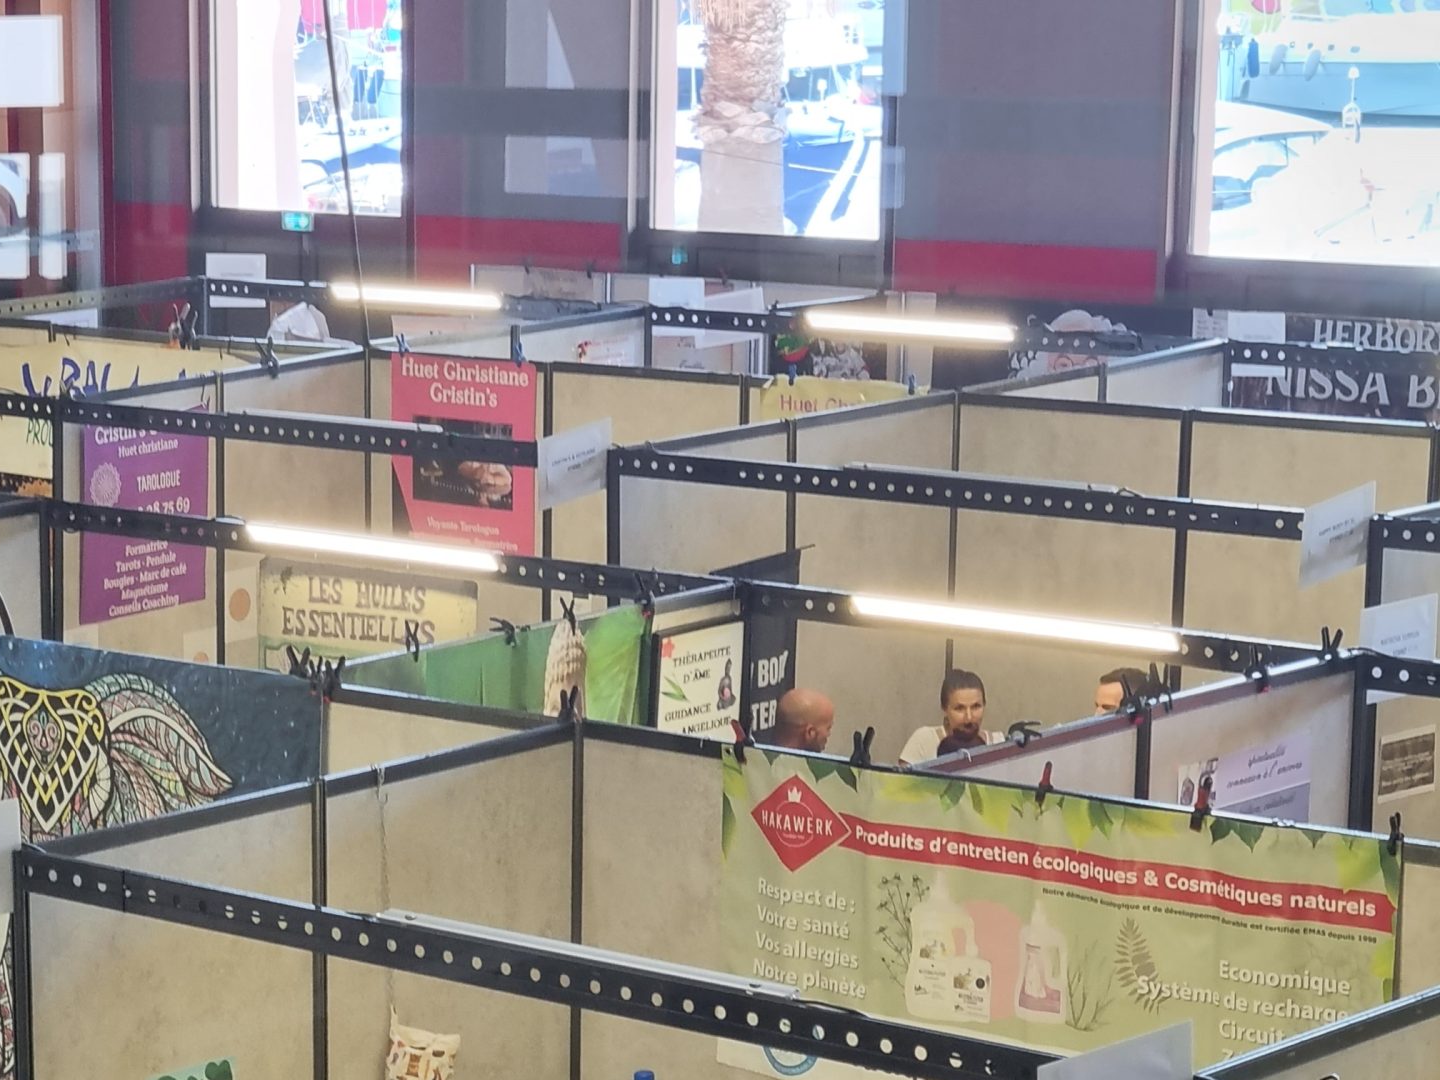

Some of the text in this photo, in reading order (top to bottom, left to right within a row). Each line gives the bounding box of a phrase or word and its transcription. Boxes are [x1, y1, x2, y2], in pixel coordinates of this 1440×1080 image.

[401, 356, 439, 379] Huet
[1407, 374, 1440, 409] B
[136, 469, 181, 493] TAROLOGUE
[308, 576, 427, 614] LES HUILES
[673, 646, 731, 667] THÉRAPEUTE
[665, 703, 711, 722] GUIDANCE
[762, 809, 833, 836] HAKAWERK
[856, 825, 1377, 918] Produits d'entretien écologiques & Cosmétiques naturels
[758, 877, 848, 911] Respect de
[757, 904, 850, 940] Votre santé
[756, 931, 859, 969] Vos allergies
[753, 958, 867, 998] Notre planète
[1137, 976, 1220, 1006] Système
[1224, 991, 1248, 1012] de
[1219, 960, 1352, 995] Economique
